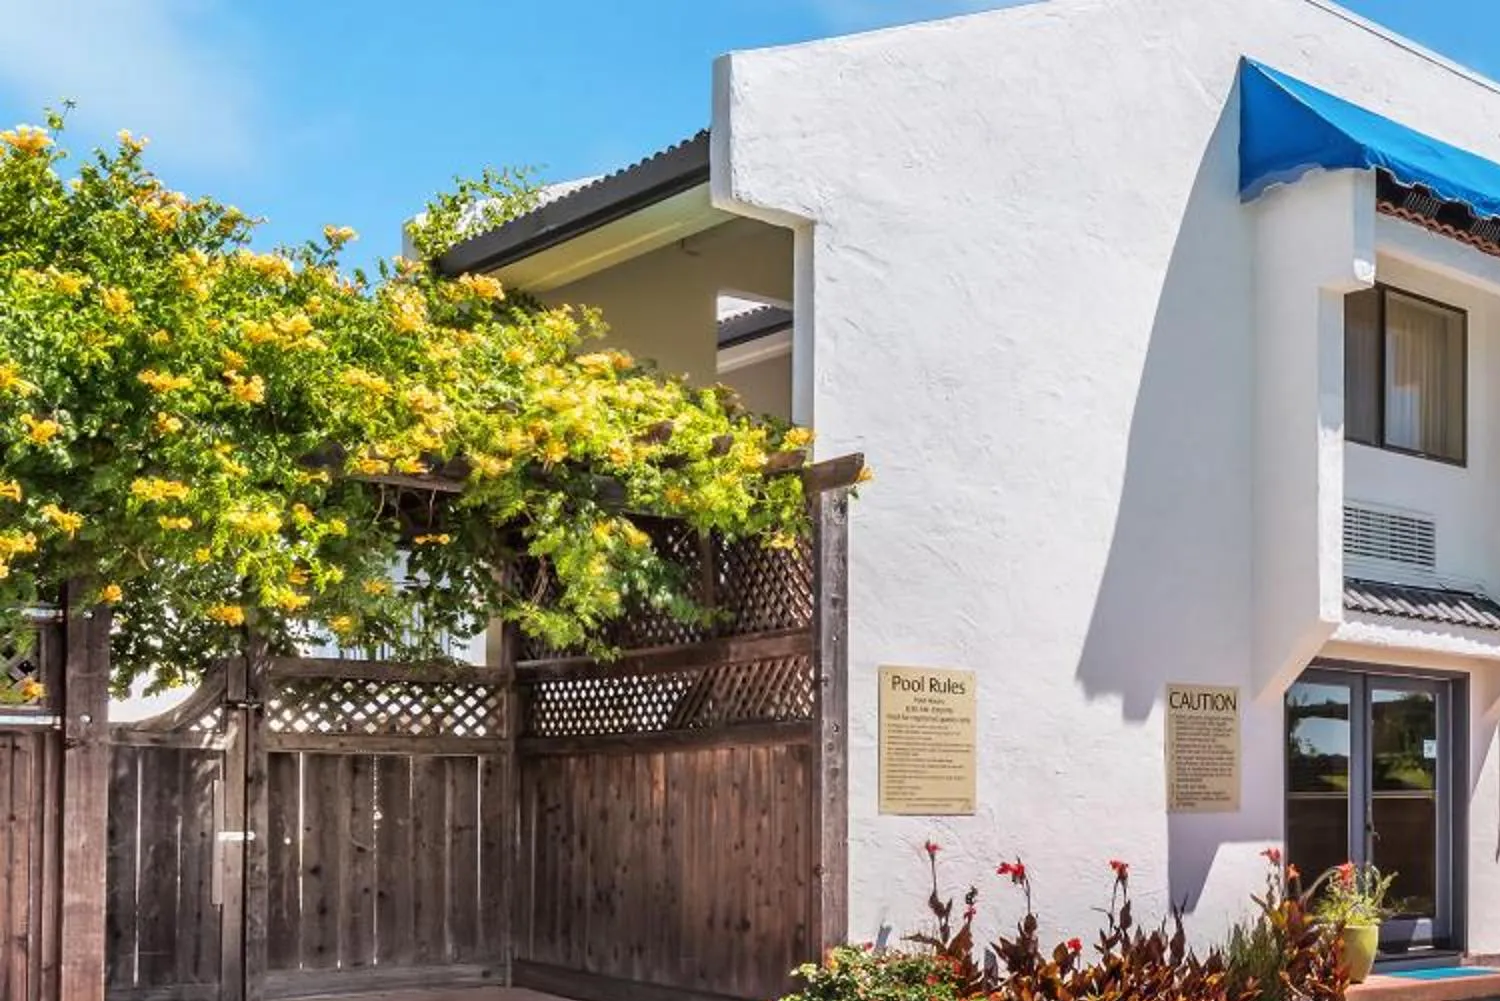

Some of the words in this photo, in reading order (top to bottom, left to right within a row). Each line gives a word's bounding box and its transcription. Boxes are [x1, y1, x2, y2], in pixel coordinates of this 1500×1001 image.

[891, 675, 925, 693] Pool
[929, 677, 966, 695] Rules
[1169, 691, 1237, 713] CAUTION
